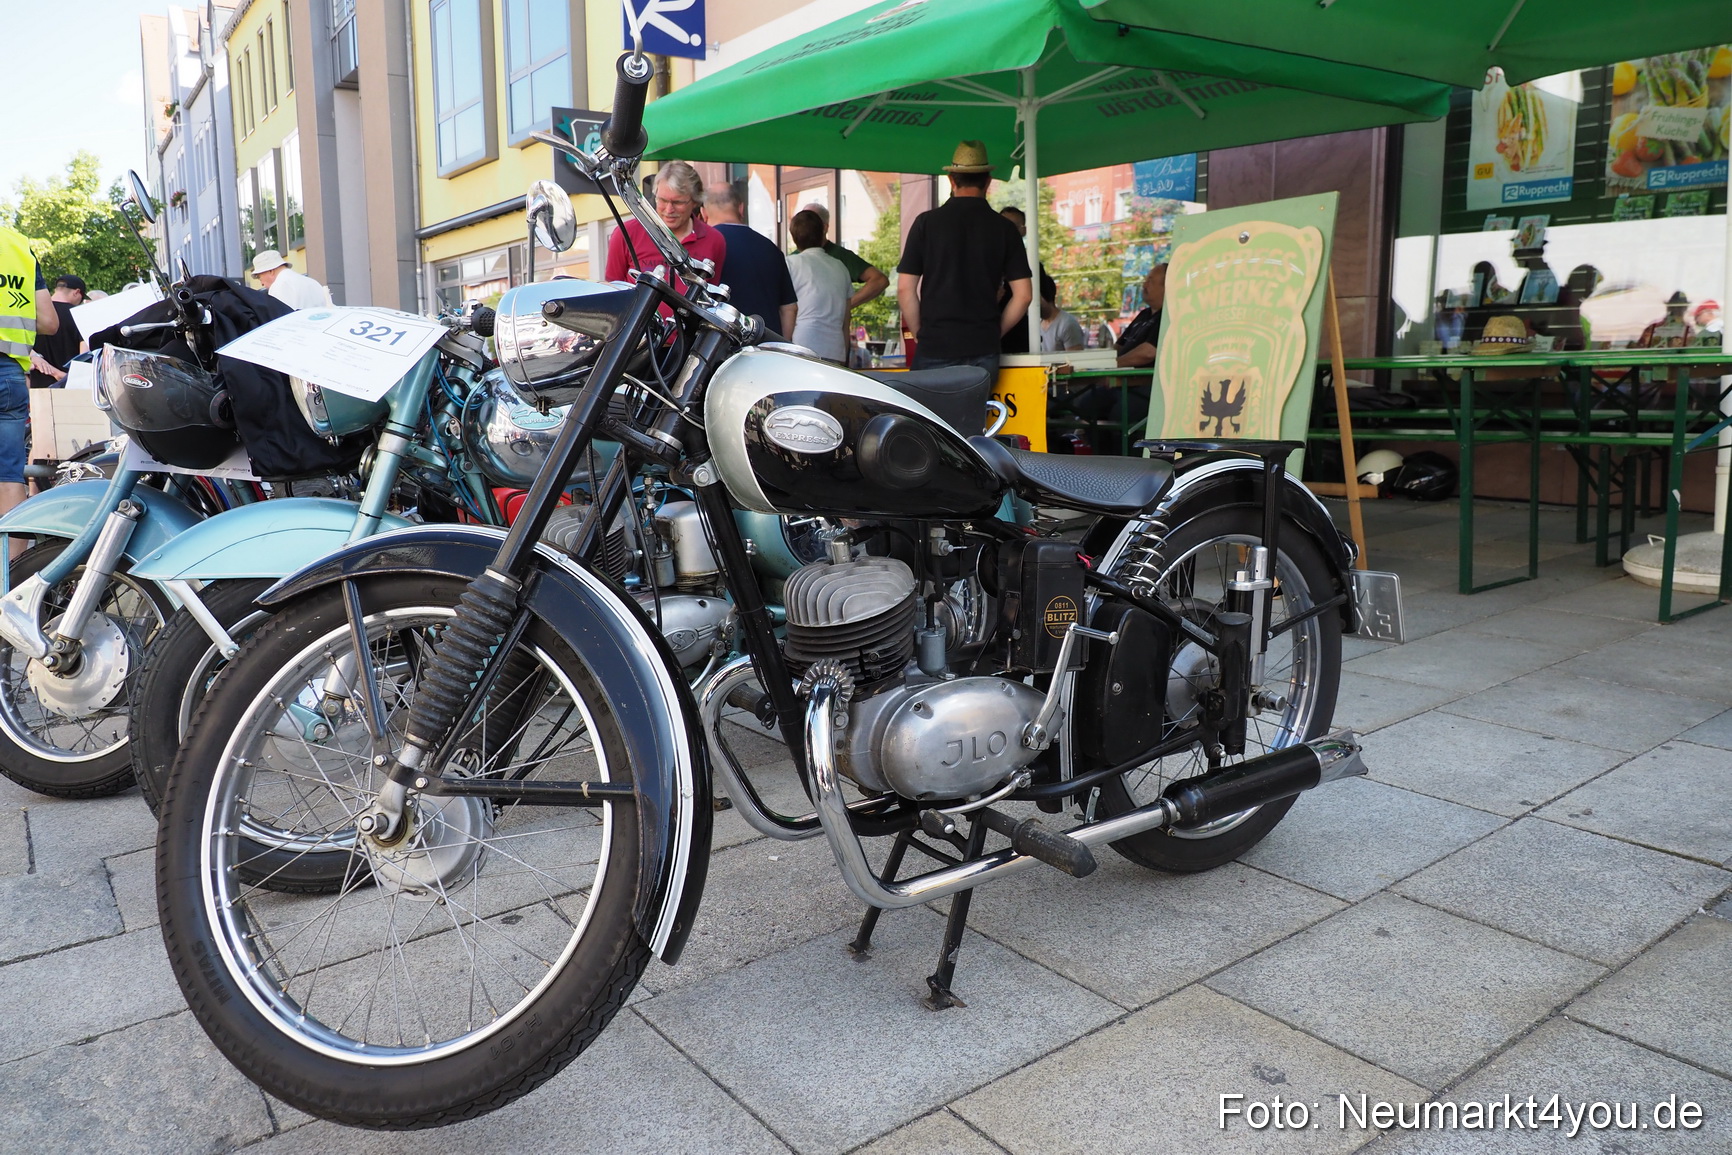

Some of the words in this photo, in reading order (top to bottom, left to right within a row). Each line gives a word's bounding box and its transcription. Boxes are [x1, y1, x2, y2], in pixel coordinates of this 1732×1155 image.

[1666, 164, 1727, 183] Rupprecht
[1518, 180, 1570, 198] Rupprecht
[1197, 279, 1279, 312] WERKE
[350, 320, 407, 346] 321
[775, 431, 829, 444] EXPRESS
[1047, 612, 1075, 622] BLITZ
